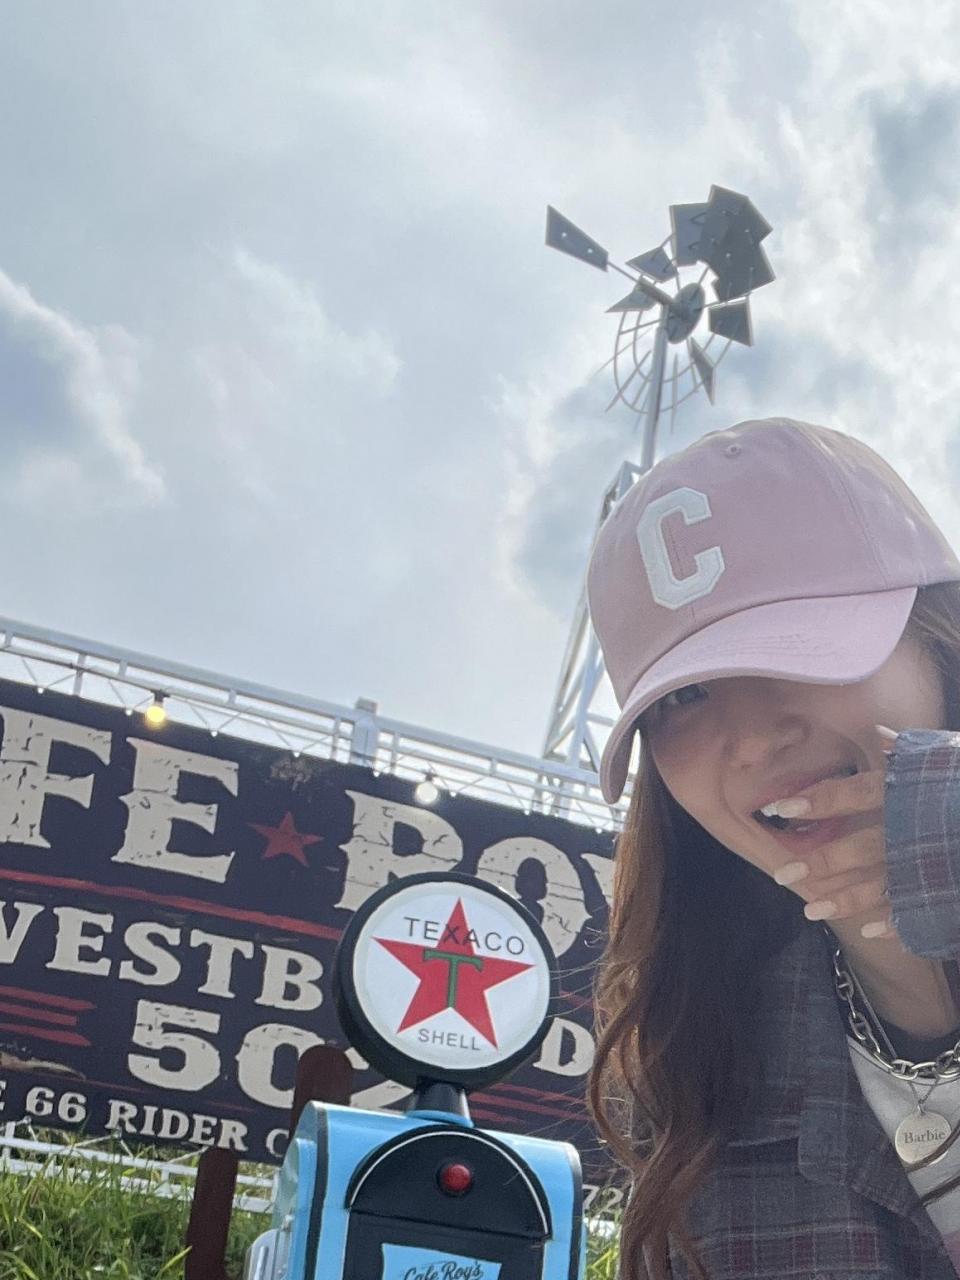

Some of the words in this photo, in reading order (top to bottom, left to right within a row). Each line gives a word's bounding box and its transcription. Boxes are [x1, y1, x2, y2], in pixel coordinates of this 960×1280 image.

[636, 487, 725, 610] C
[403, 916, 525, 956] TEXACO
[417, 1028, 481, 1051] SHELL
[26, 1085, 87, 1122] 66
[105, 1099, 249, 1151] RIDER
[903, 1129, 946, 1144] Barbie
